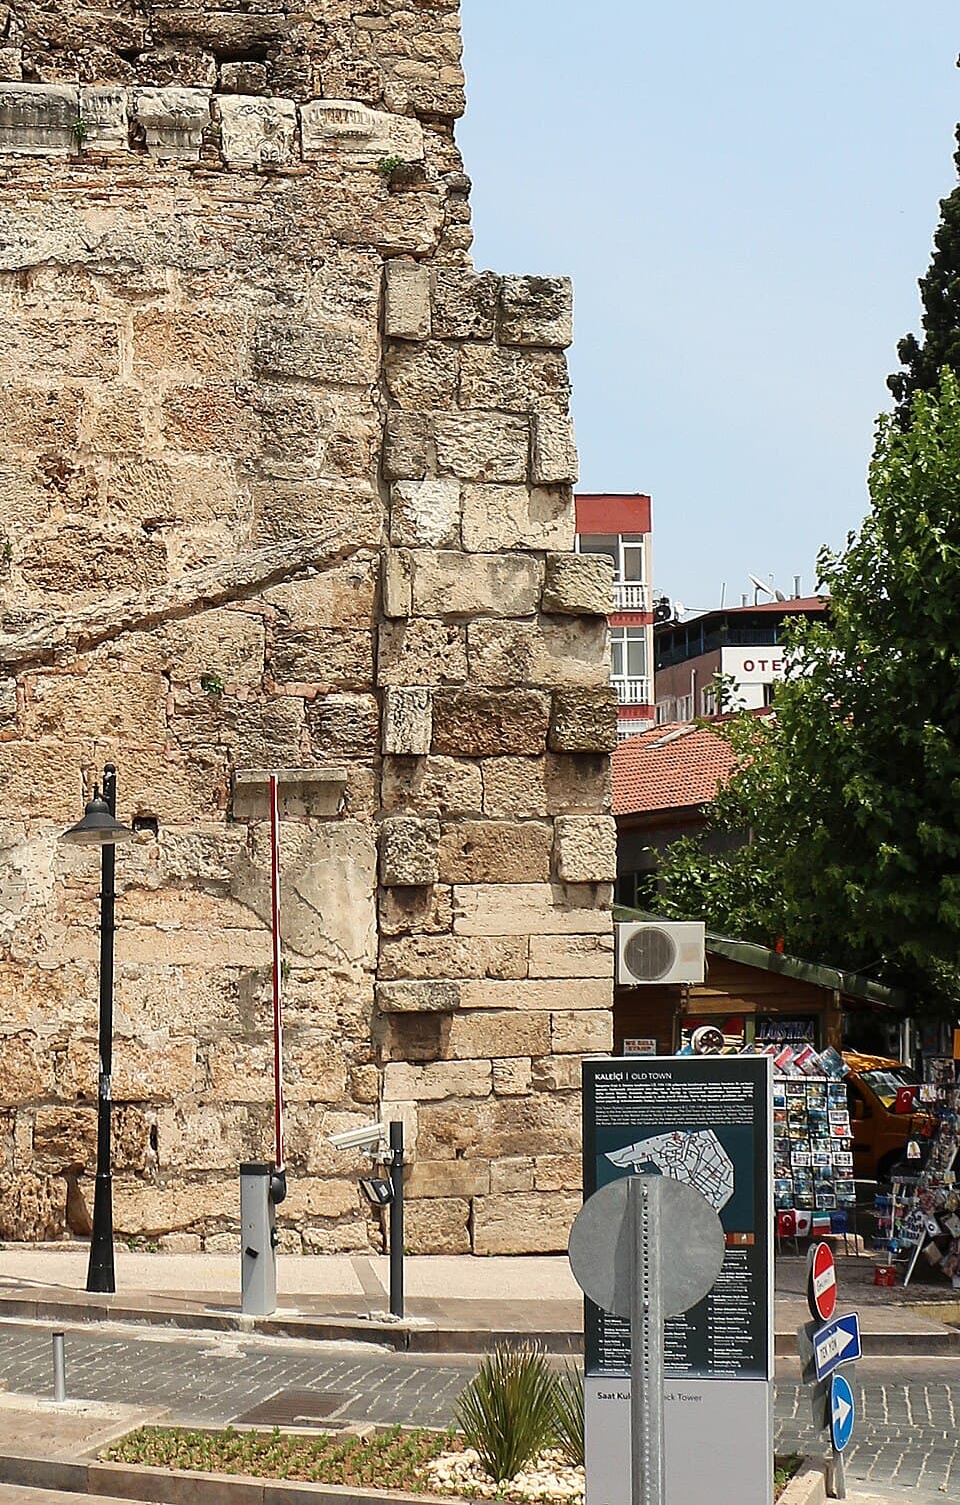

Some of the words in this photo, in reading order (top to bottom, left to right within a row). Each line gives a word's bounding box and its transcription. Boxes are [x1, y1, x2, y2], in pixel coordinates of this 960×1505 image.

[631, 1072, 647, 1080] OLD
[648, 1071, 673, 1080] TOWN
[597, 1391, 615, 1400] Saat
[678, 1393, 703, 1402] Tower
